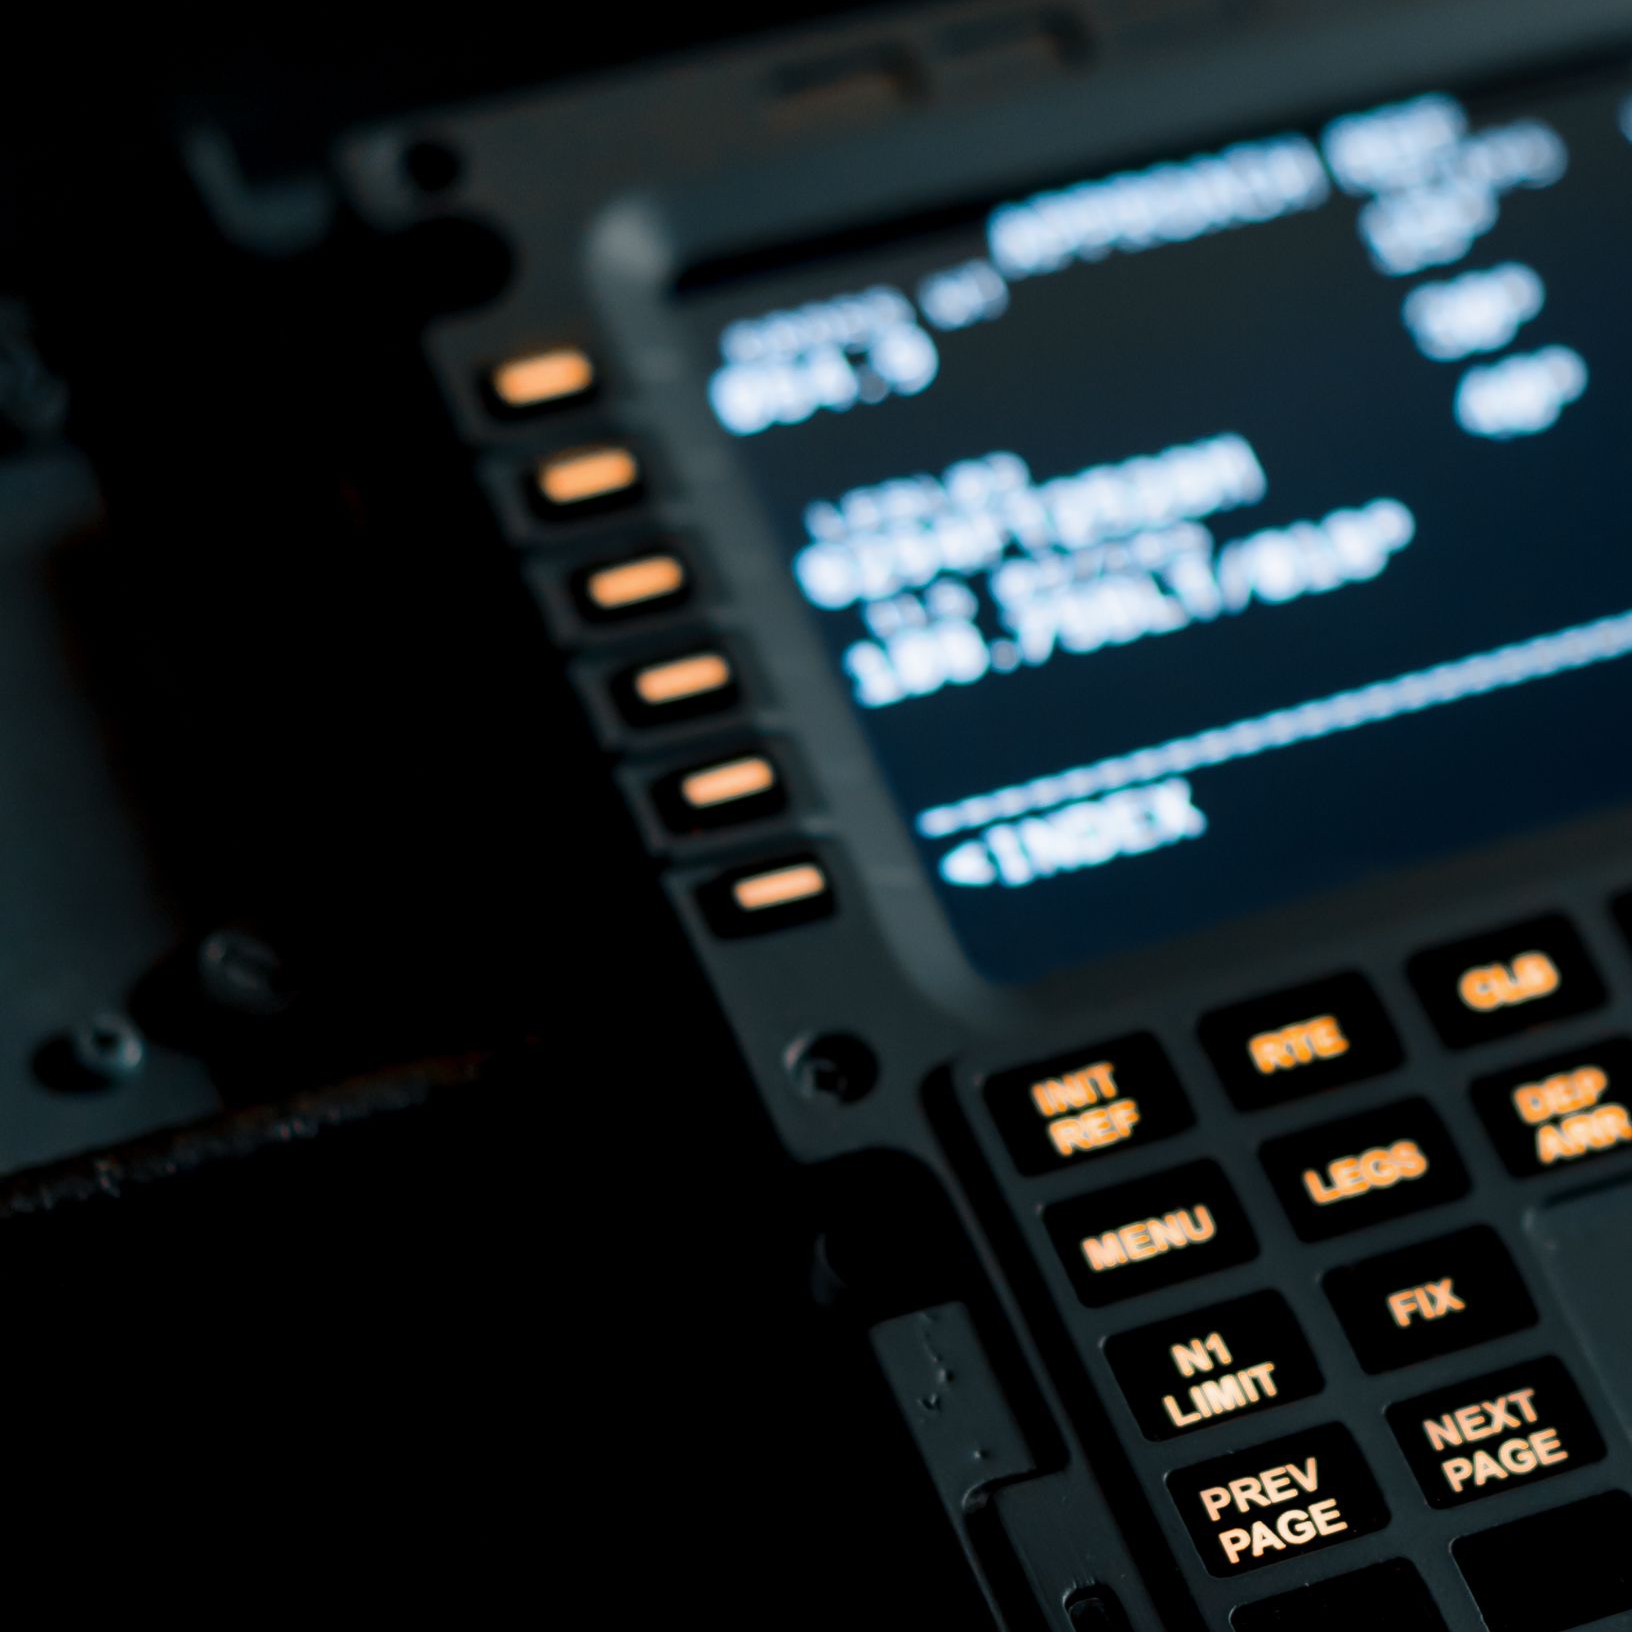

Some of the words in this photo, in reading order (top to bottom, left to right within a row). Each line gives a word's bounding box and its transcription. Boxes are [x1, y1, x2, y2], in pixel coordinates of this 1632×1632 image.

[1461, 954, 1558, 1009] CLB
[1250, 1017, 1348, 1073] RTE
[1033, 1064, 1116, 1111] INIT
[1516, 1069, 1608, 1117] DEP
[1048, 1101, 1139, 1155] REF
[1304, 1142, 1427, 1203] LEGS
[1083, 1206, 1214, 1270] MENU
[1388, 1279, 1464, 1326] FIX
[1172, 1334, 1231, 1377] N1
[1164, 1363, 1276, 1427] LIMIT
[1424, 1389, 1537, 1450] NEXT
[1442, 1429, 1568, 1492] PAGE
[1201, 1461, 1319, 1521] PREV
[1219, 1500, 1347, 1562] PAGE
